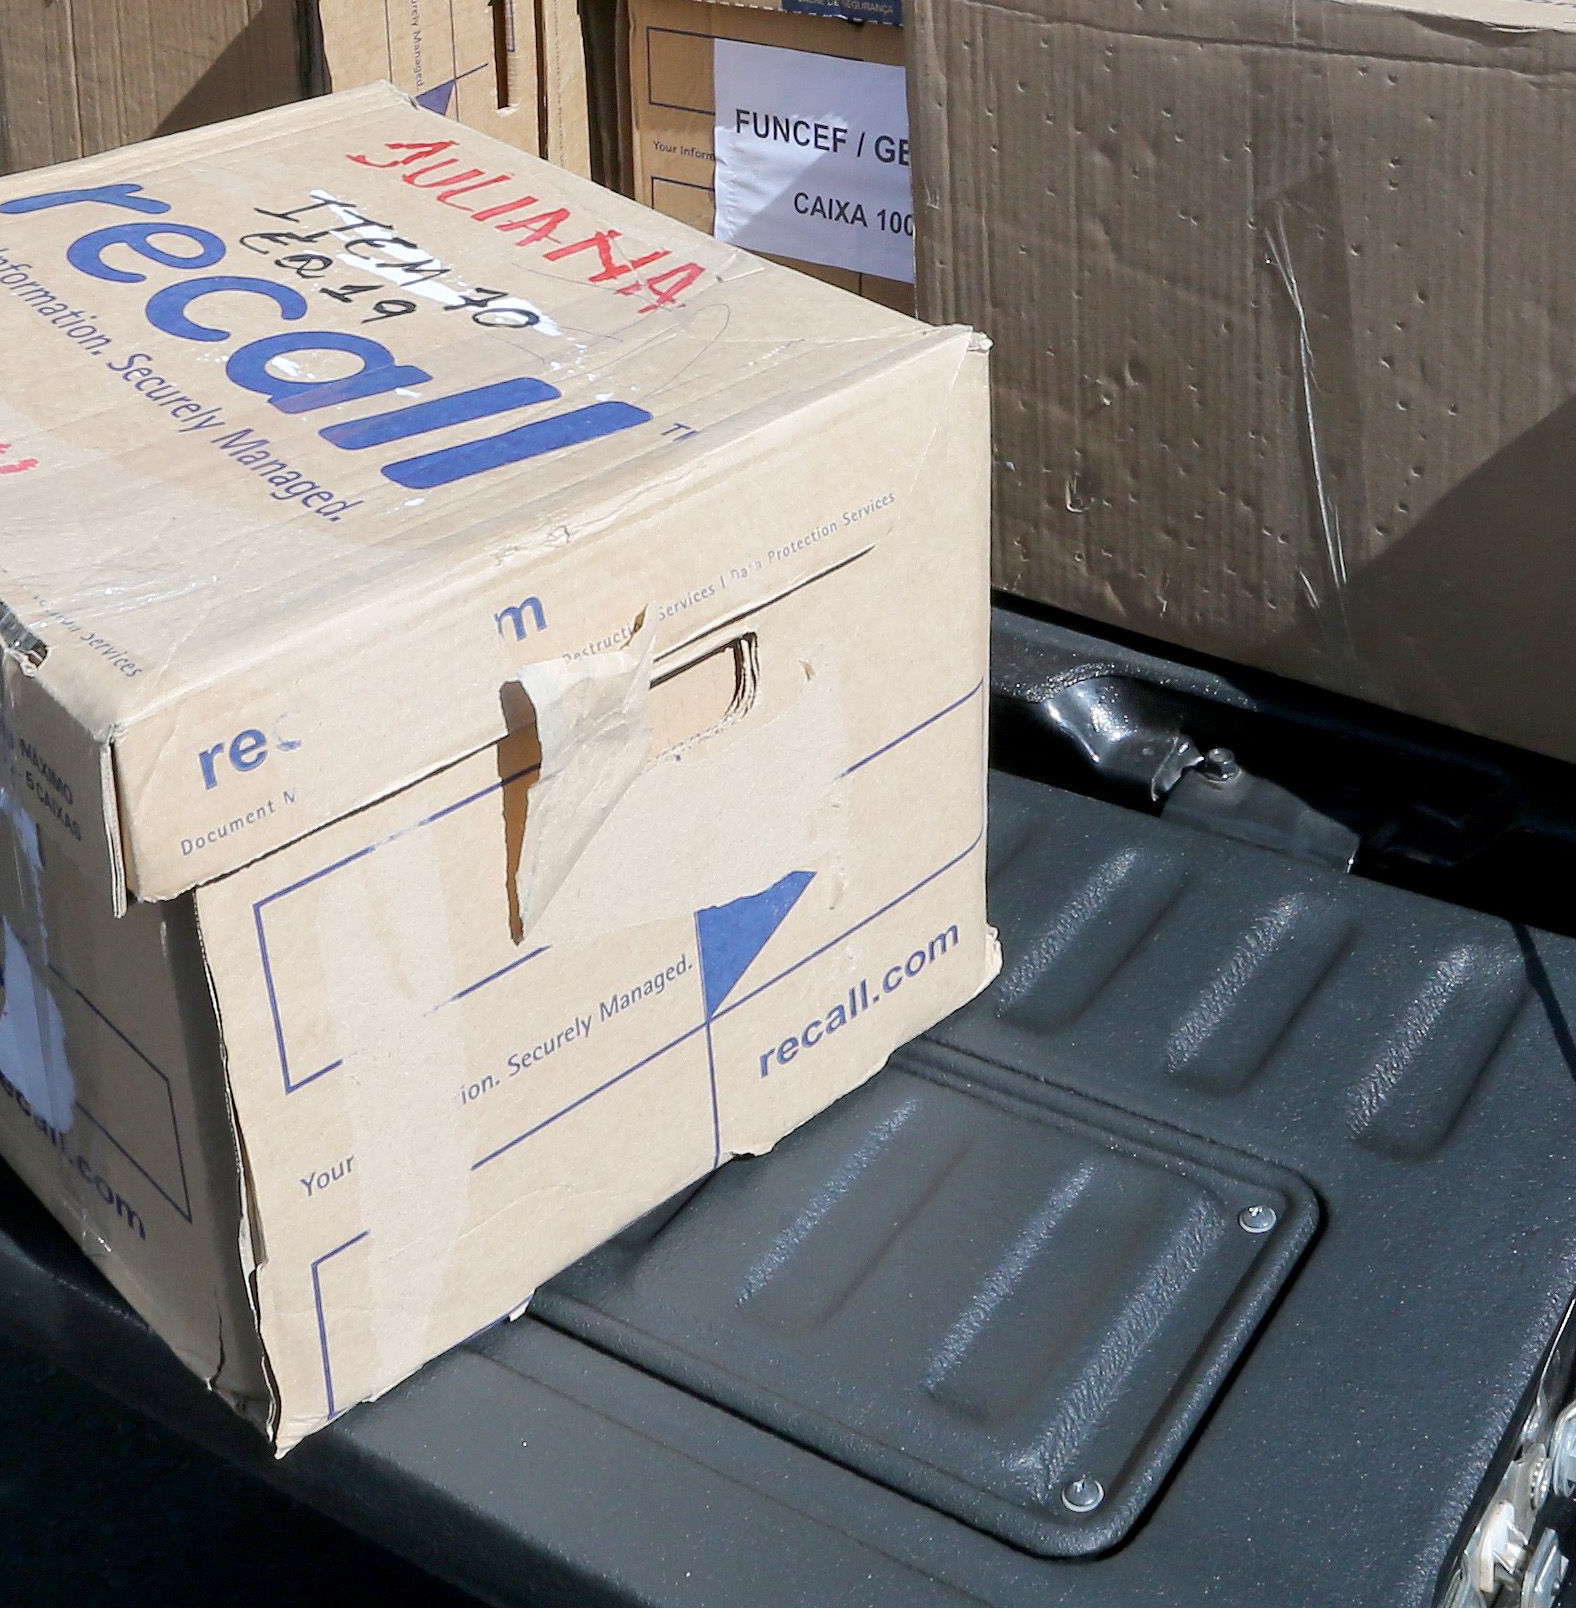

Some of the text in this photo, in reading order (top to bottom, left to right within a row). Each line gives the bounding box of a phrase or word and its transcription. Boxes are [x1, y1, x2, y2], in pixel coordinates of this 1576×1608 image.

[413, 29, 423, 90] Managed.
[652, 139, 677, 155] Your
[735, 108, 849, 153] FUNCEF
[345, 140, 706, 314] JULIANA
[793, 192, 868, 228] CAIXA
[253, 194, 540, 328] ITEM 70
[319, 285, 417, 325] 19
[106, 352, 226, 434] Securely
[210, 426, 365, 523] Managed.
[767, 521, 838, 563] Protection
[840, 491, 897, 528] Services
[181, 800, 274, 856] Document
[506, 957, 694, 1077] Securely Managed.
[758, 923, 961, 1079] recall.com
[299, 1152, 356, 1198] Your
